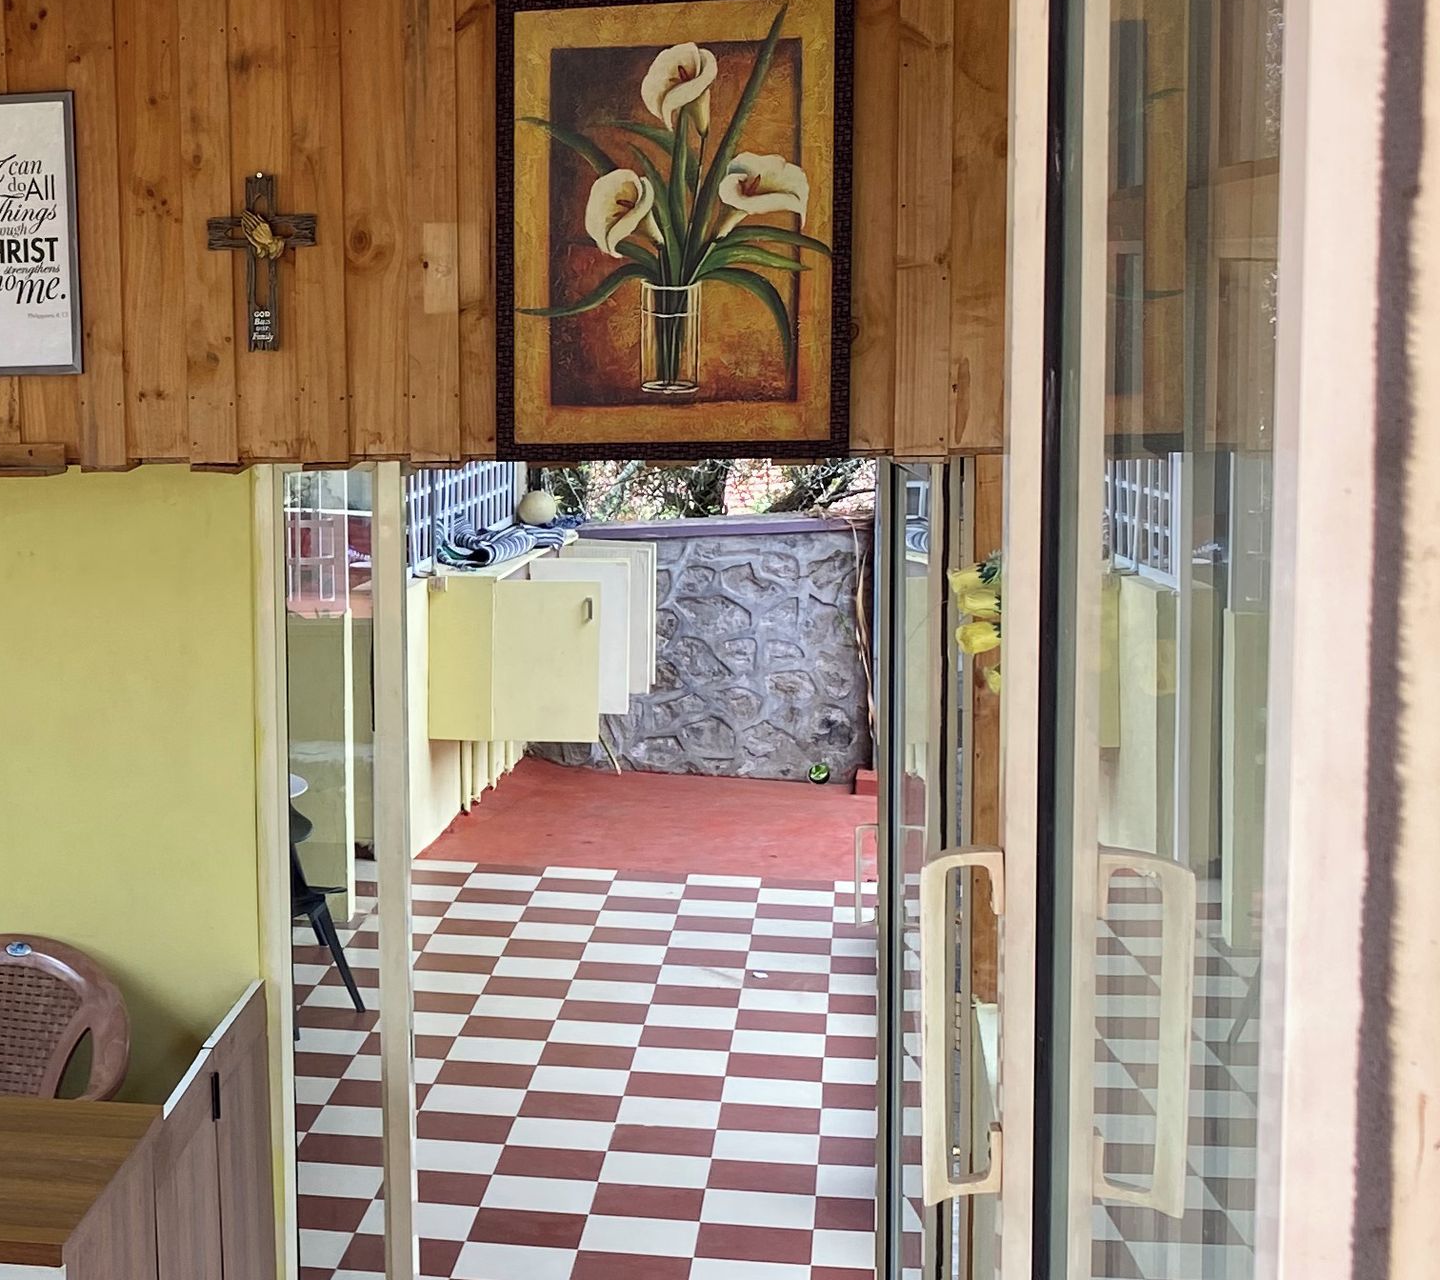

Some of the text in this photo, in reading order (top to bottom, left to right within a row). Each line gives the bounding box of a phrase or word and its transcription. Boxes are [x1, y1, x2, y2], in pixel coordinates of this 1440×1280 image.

[8, 160, 42, 176] can
[7, 174, 55, 201] do All
[4, 261, 60, 279] strengthens
